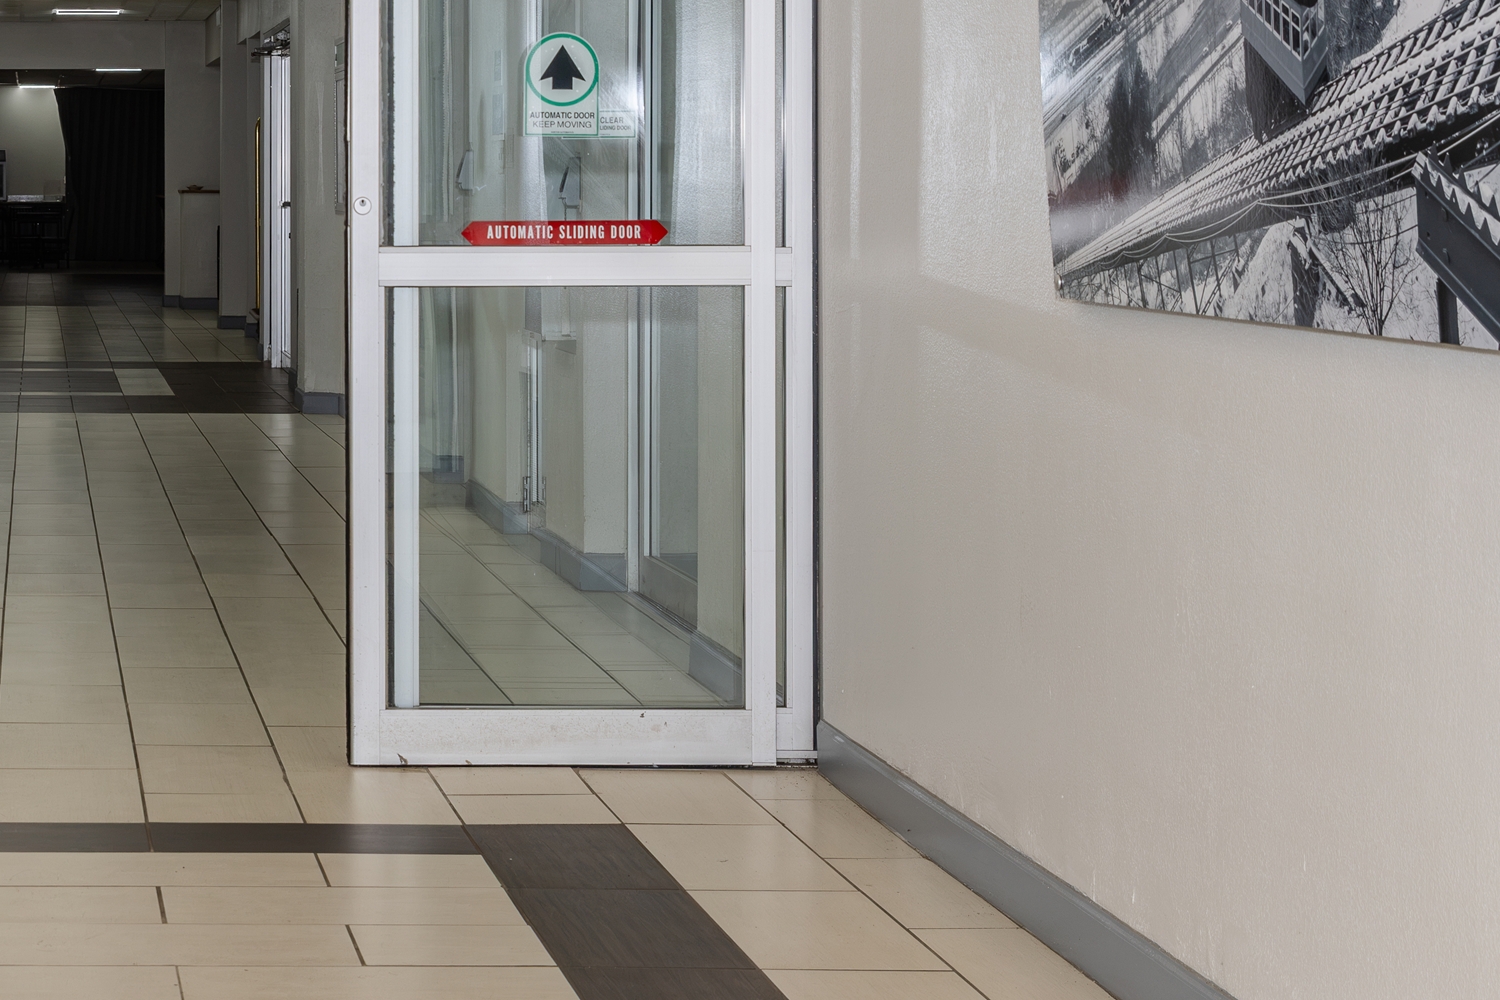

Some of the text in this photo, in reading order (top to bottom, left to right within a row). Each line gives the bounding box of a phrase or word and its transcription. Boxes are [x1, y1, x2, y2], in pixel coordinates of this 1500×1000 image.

[487, 225, 641, 239] AUTOMATIC SLIDING DOOR
